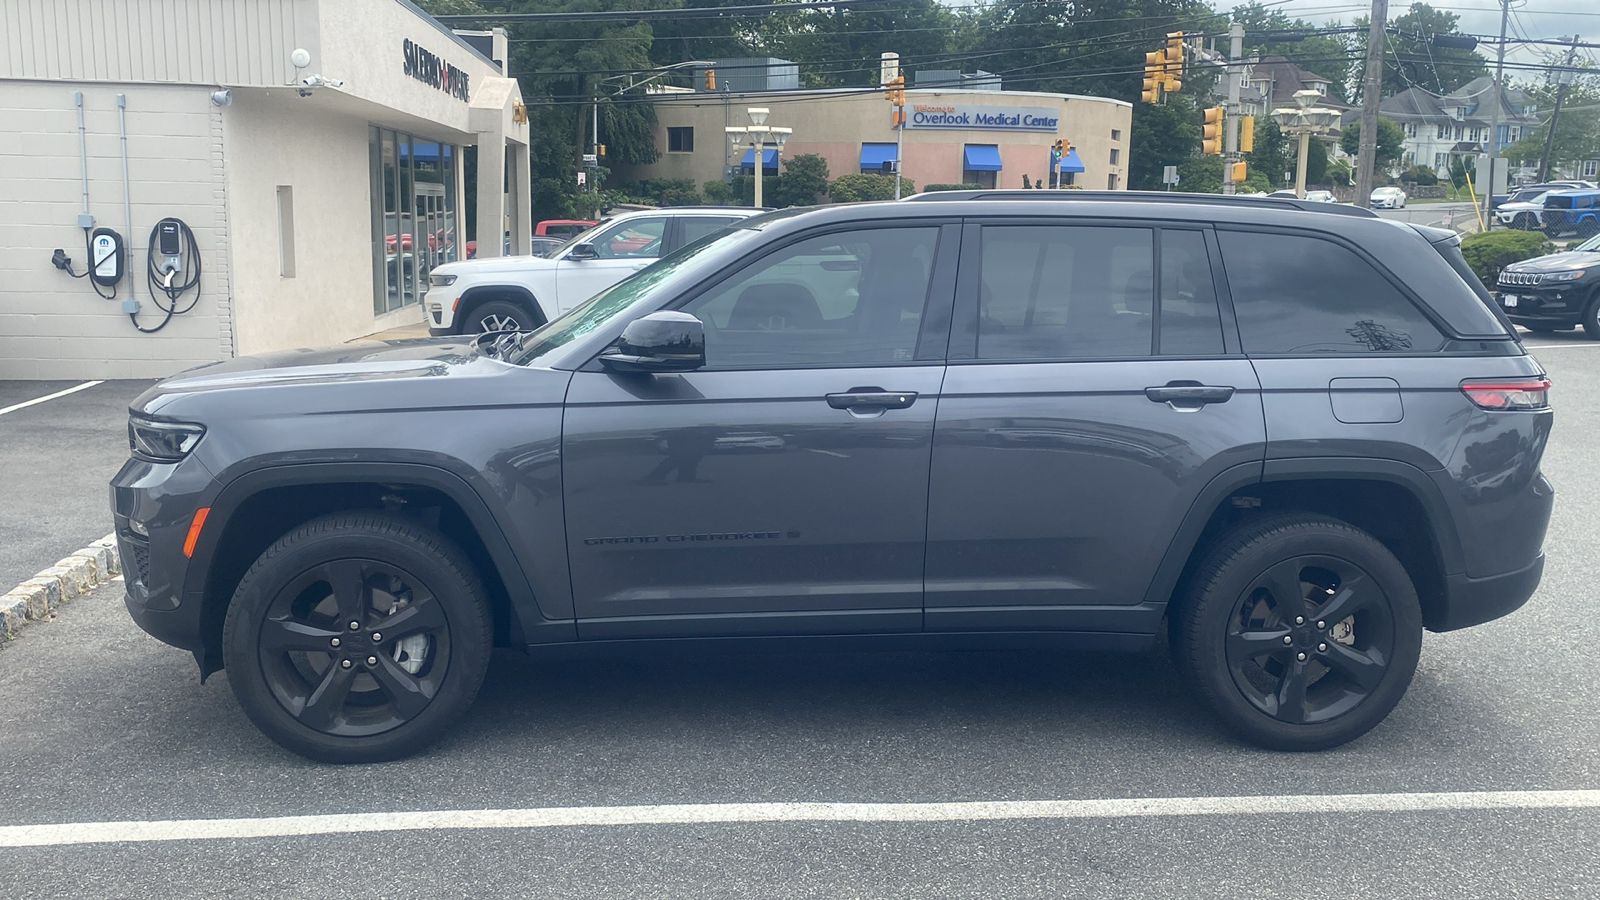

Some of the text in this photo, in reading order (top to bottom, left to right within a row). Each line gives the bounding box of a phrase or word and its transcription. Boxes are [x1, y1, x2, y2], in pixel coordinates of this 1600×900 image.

[914, 104, 955, 113] Welcome to
[913, 111, 1059, 127] Overlook Medical Center
[583, 530, 780, 546] GRAND CHEROKEE
